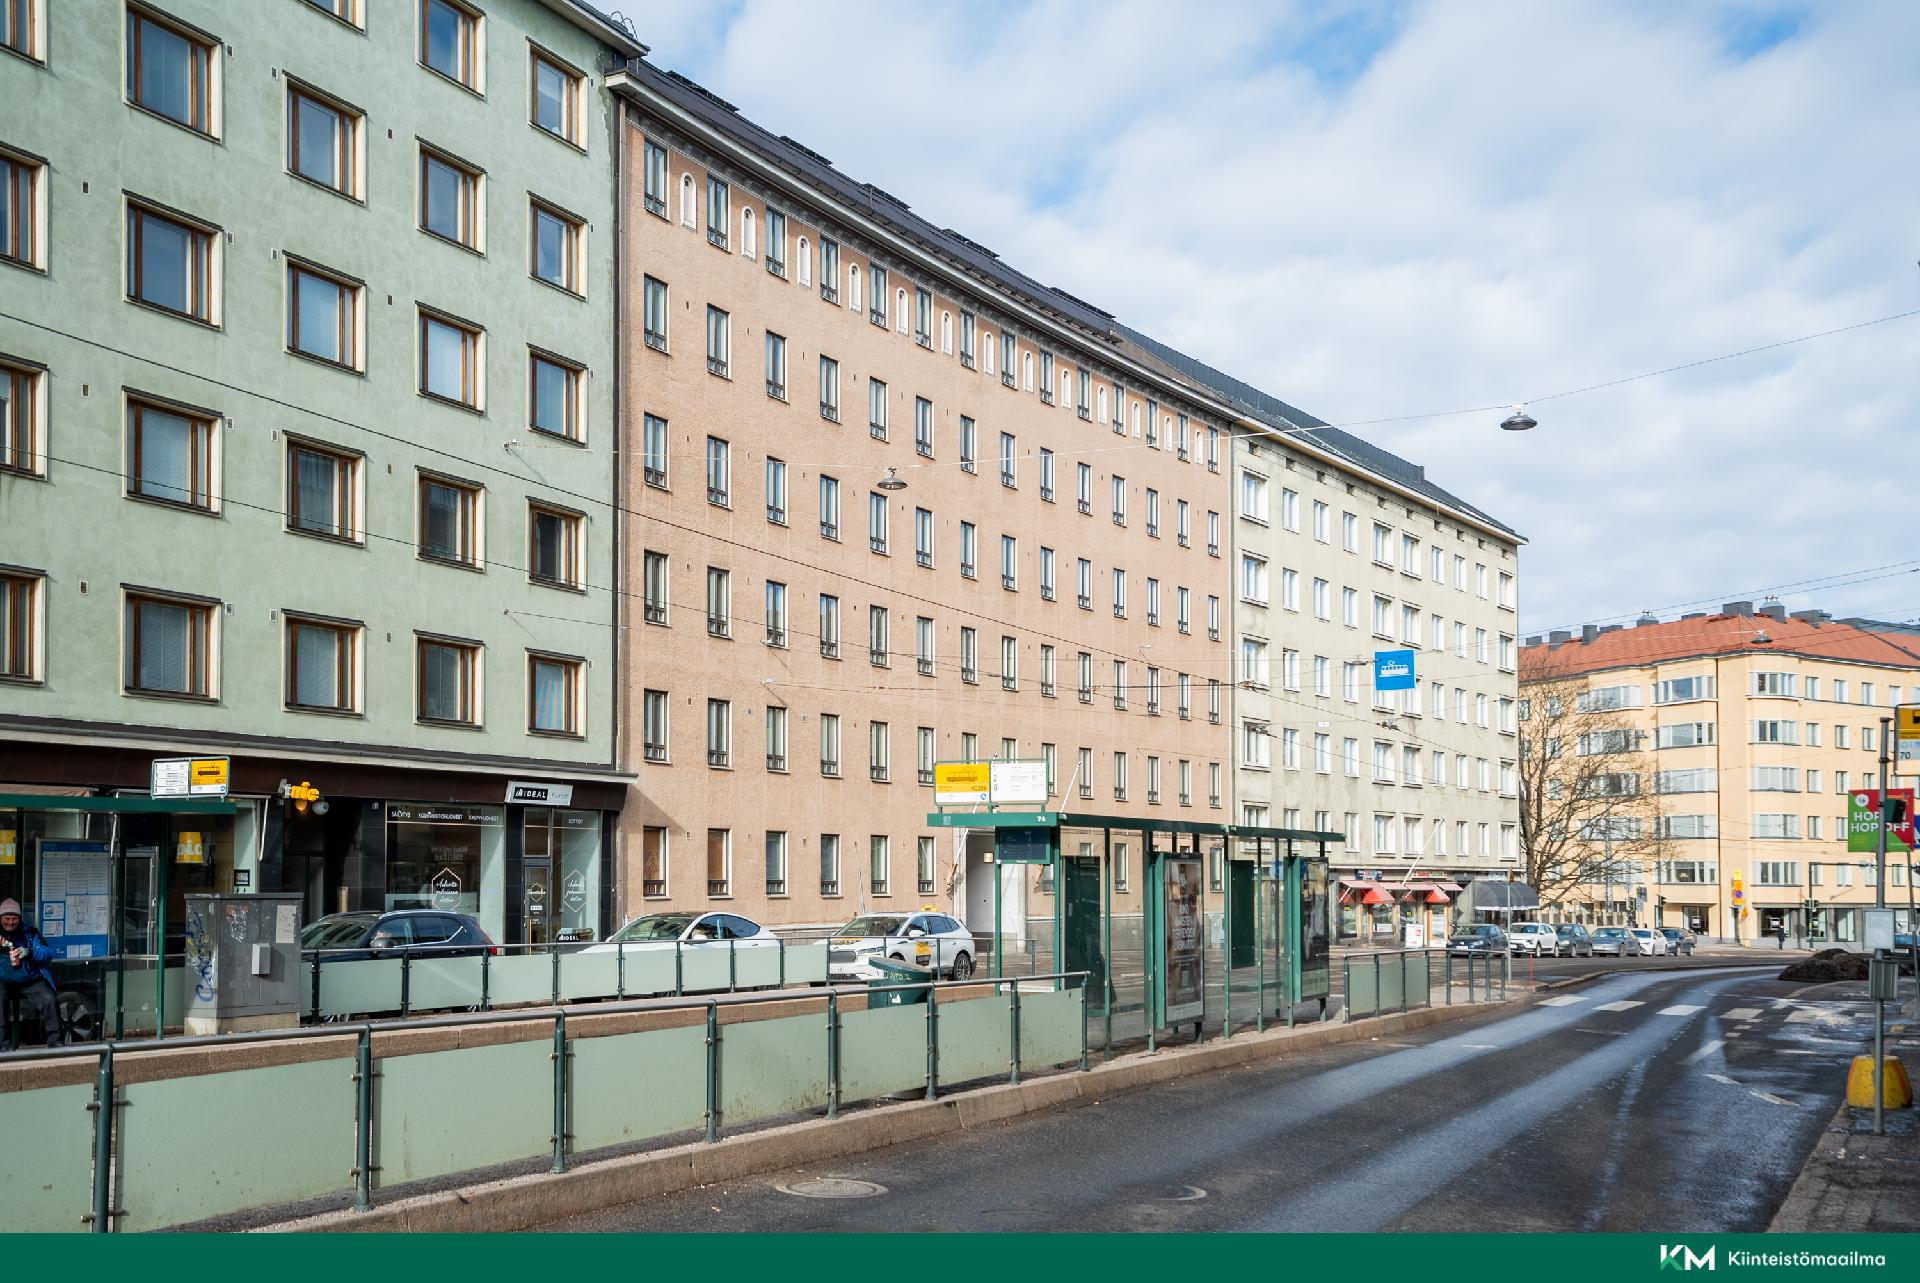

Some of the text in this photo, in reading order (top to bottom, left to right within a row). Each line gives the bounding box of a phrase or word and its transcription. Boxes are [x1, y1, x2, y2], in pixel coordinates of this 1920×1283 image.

[1900, 751, 1911, 759] 70
[523, 790, 546, 798] IDEAL
[1854, 811, 1879, 821] HOP
[1851, 822, 1879, 832] HOP
